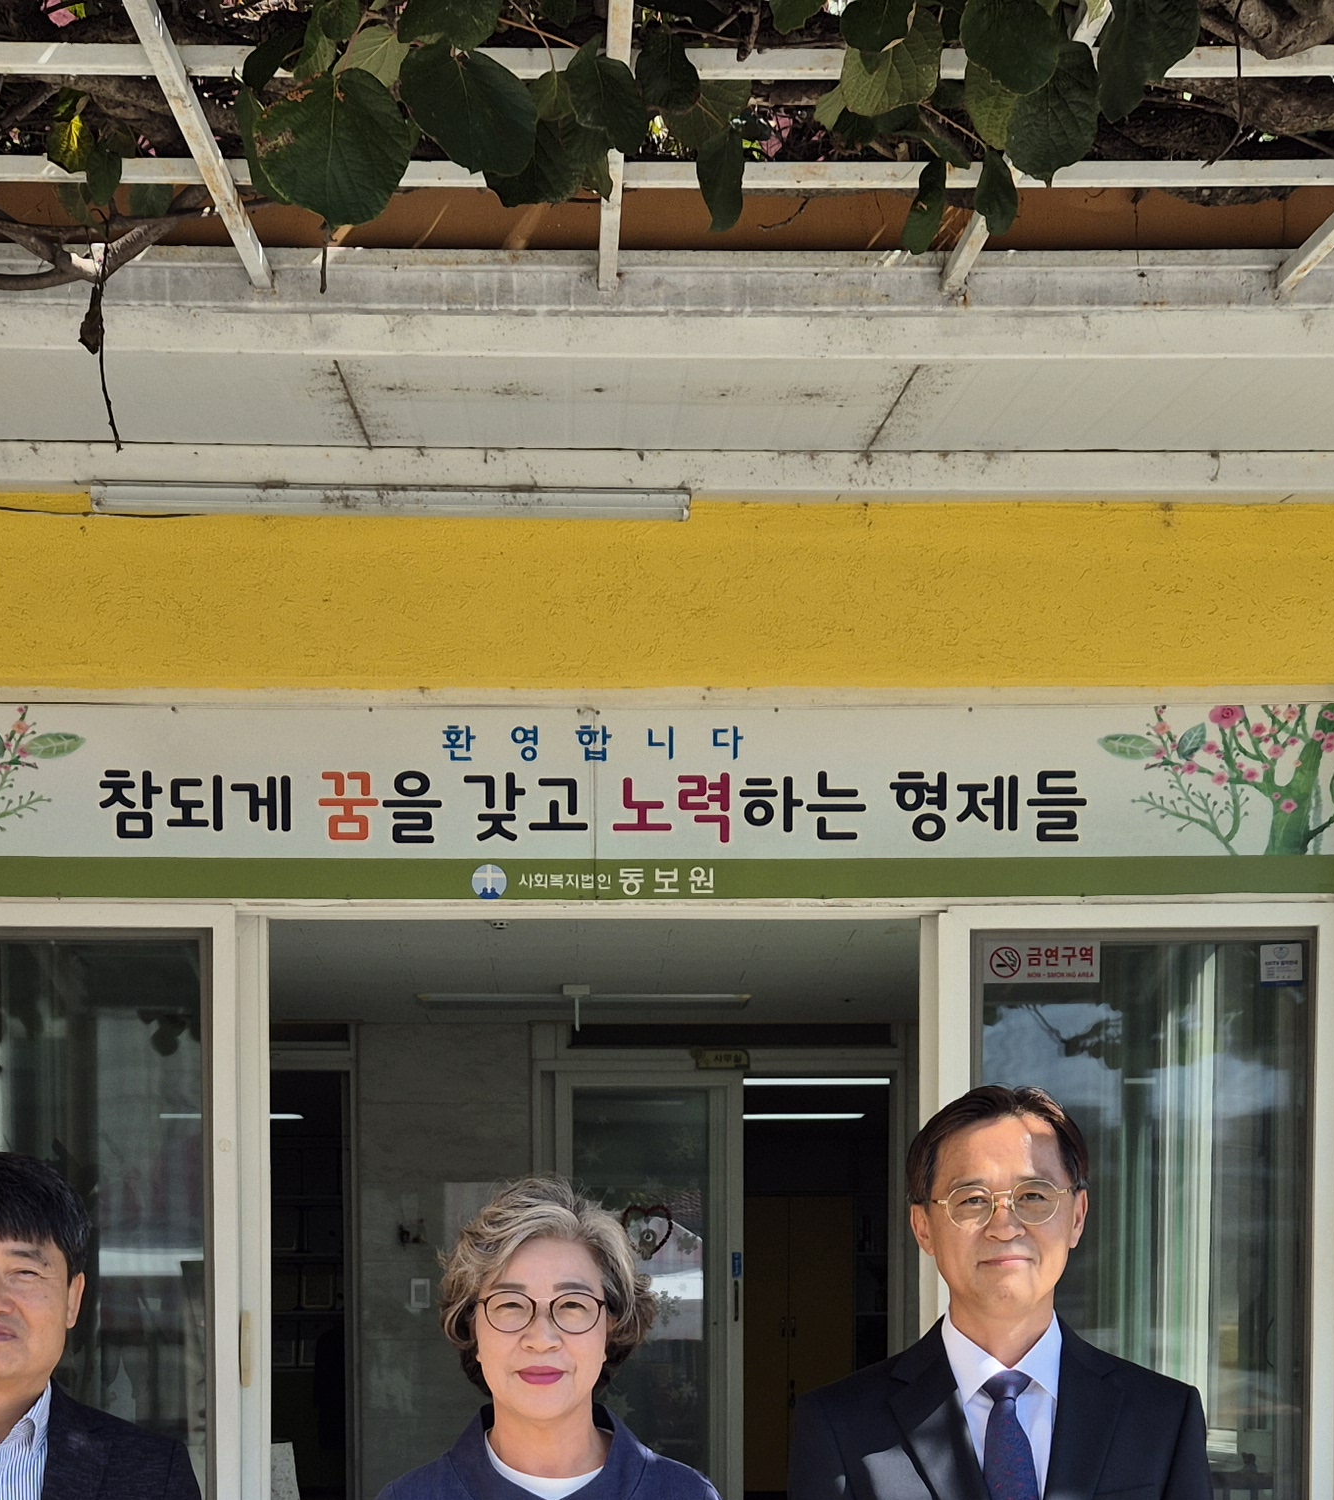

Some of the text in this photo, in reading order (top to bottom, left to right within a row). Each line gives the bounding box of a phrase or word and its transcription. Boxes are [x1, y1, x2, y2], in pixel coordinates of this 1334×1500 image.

[99, 769, 1087, 844] 참되게 꿈을 갖고 노력하는 형제들
[518, 866, 715, 896] 사회복지법인 동보원
[1026, 947, 1095, 967] 금연구역
